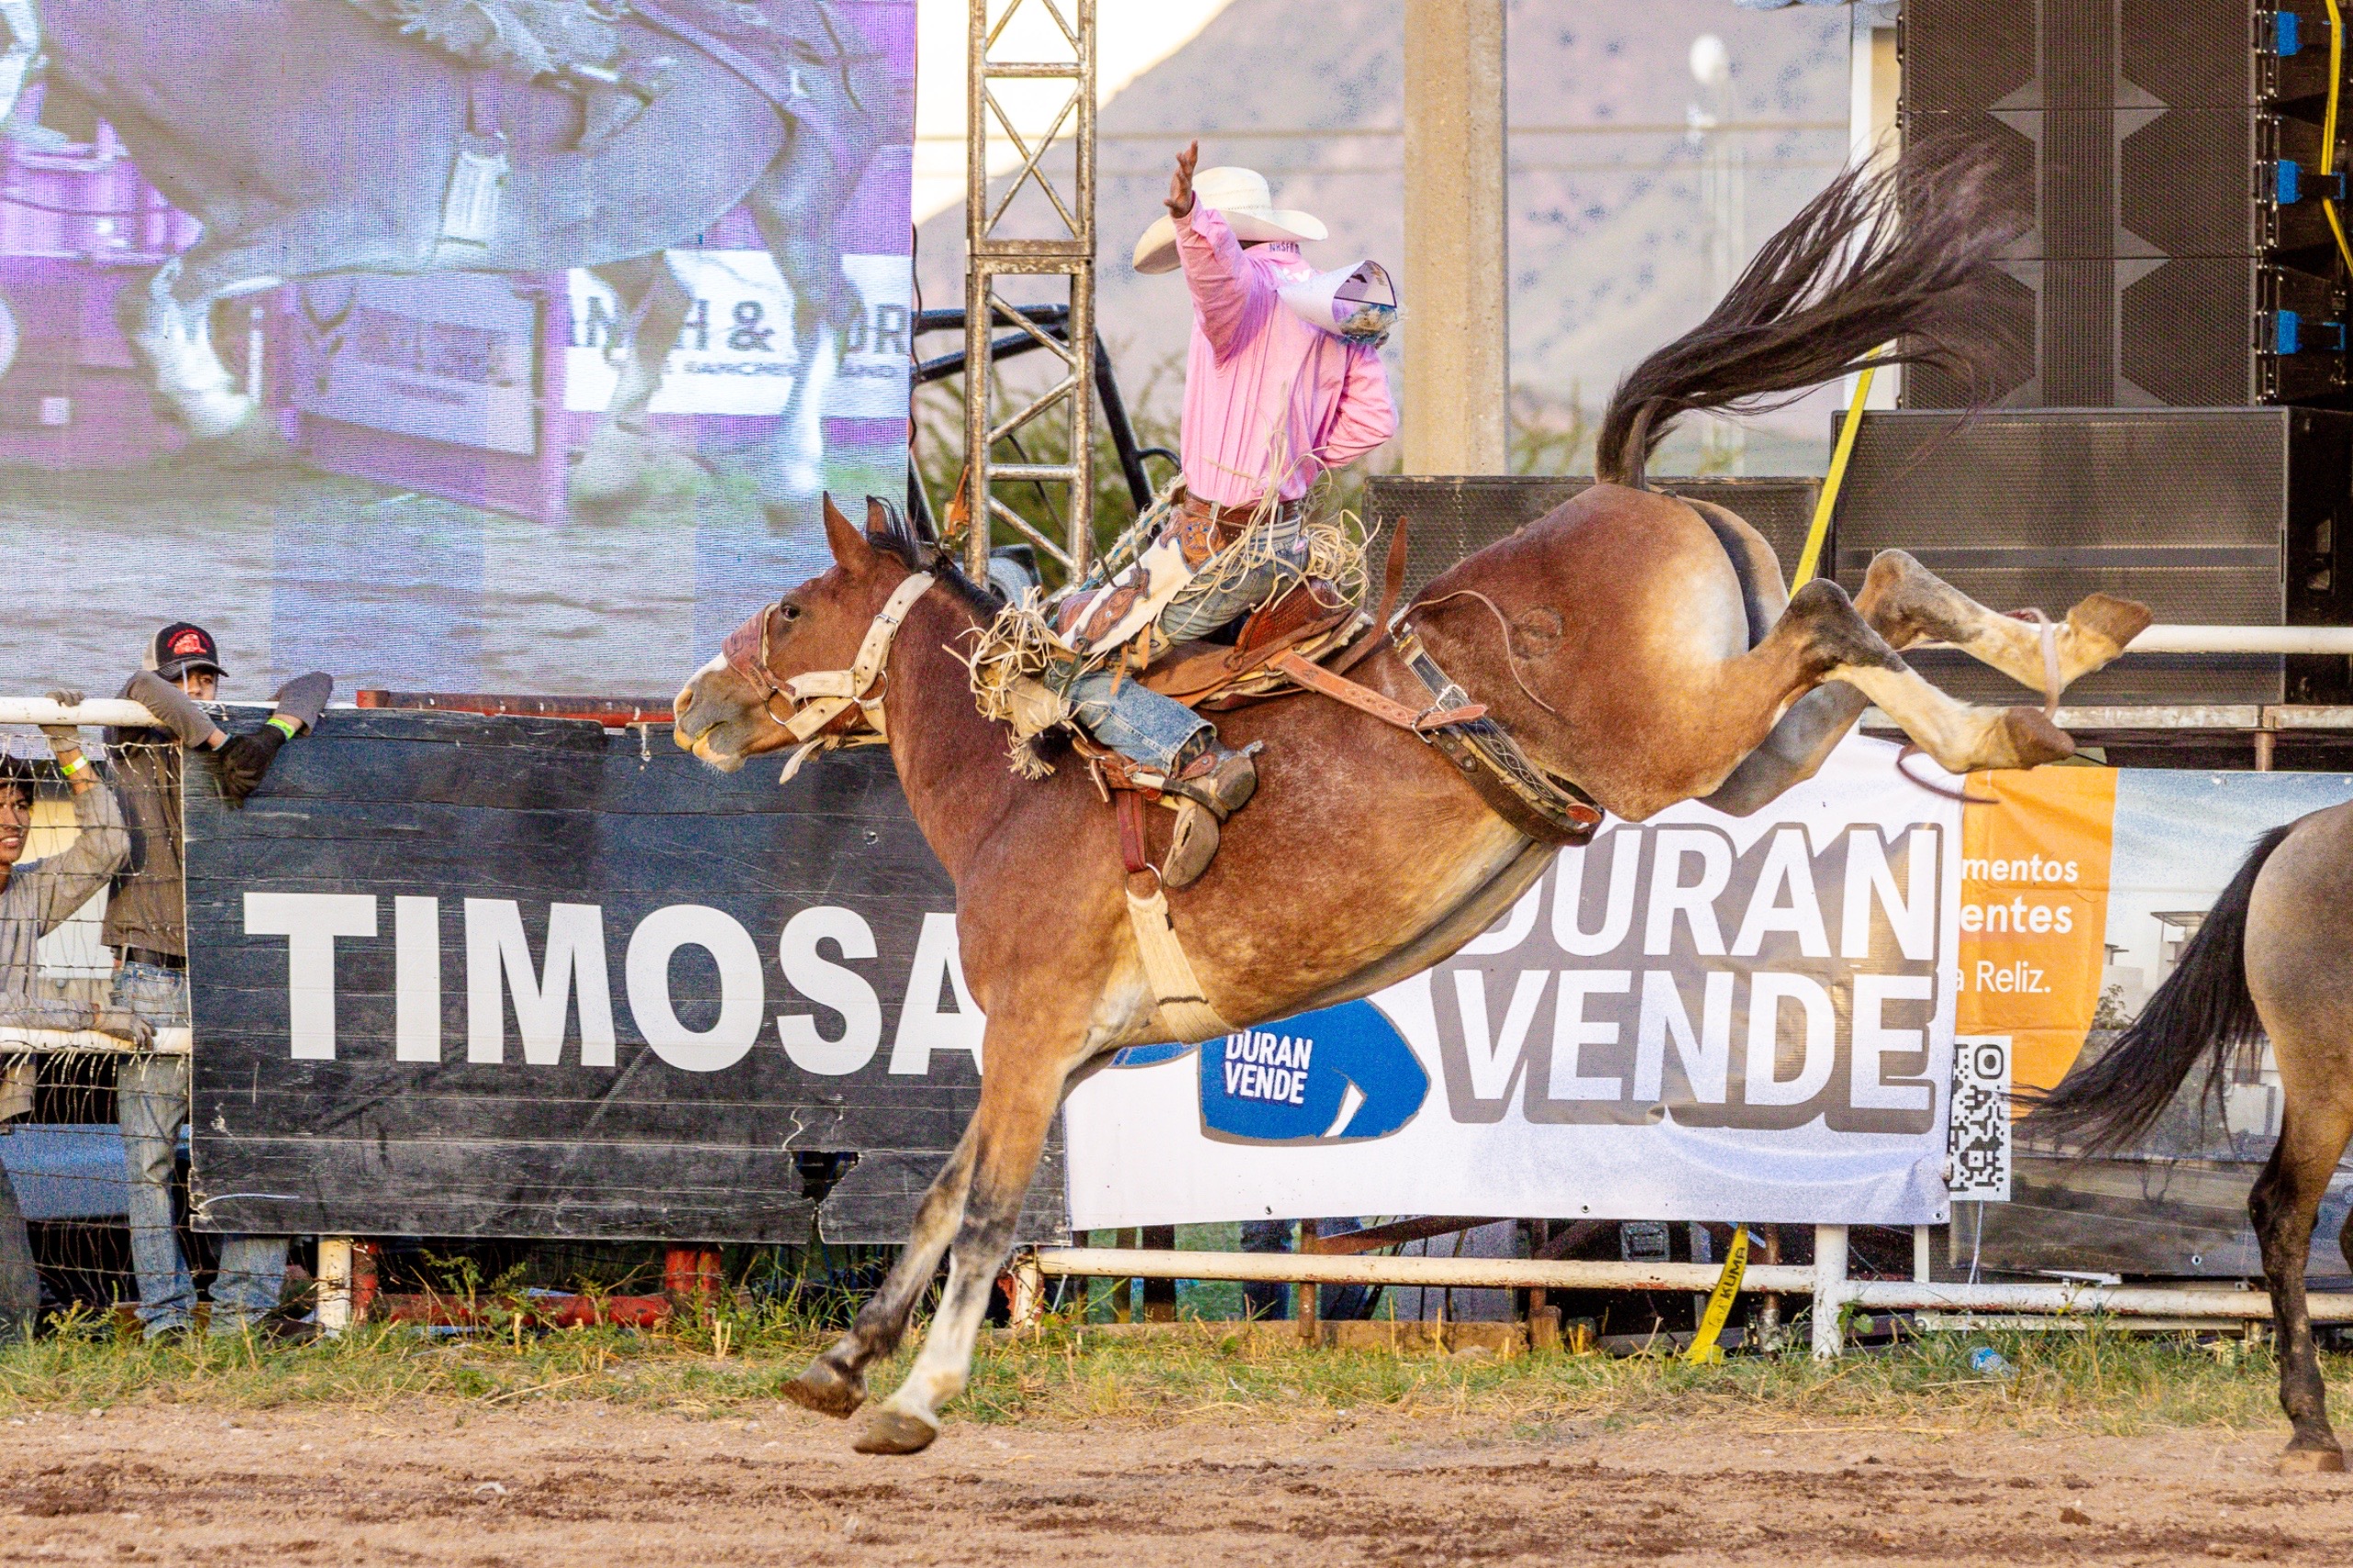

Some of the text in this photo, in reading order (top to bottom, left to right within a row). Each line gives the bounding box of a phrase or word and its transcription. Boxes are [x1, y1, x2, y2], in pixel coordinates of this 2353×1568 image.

[1961, 853, 2079, 883] mentos
[1960, 895, 2074, 935] entes
[1976, 960, 2052, 994] Reliz.
[1225, 1029, 1313, 1070] DURAN
[1452, 969, 1931, 1111] VENDE
[1224, 1061, 1308, 1105] VENDE
[1720, 1247, 1745, 1300] KUMA
